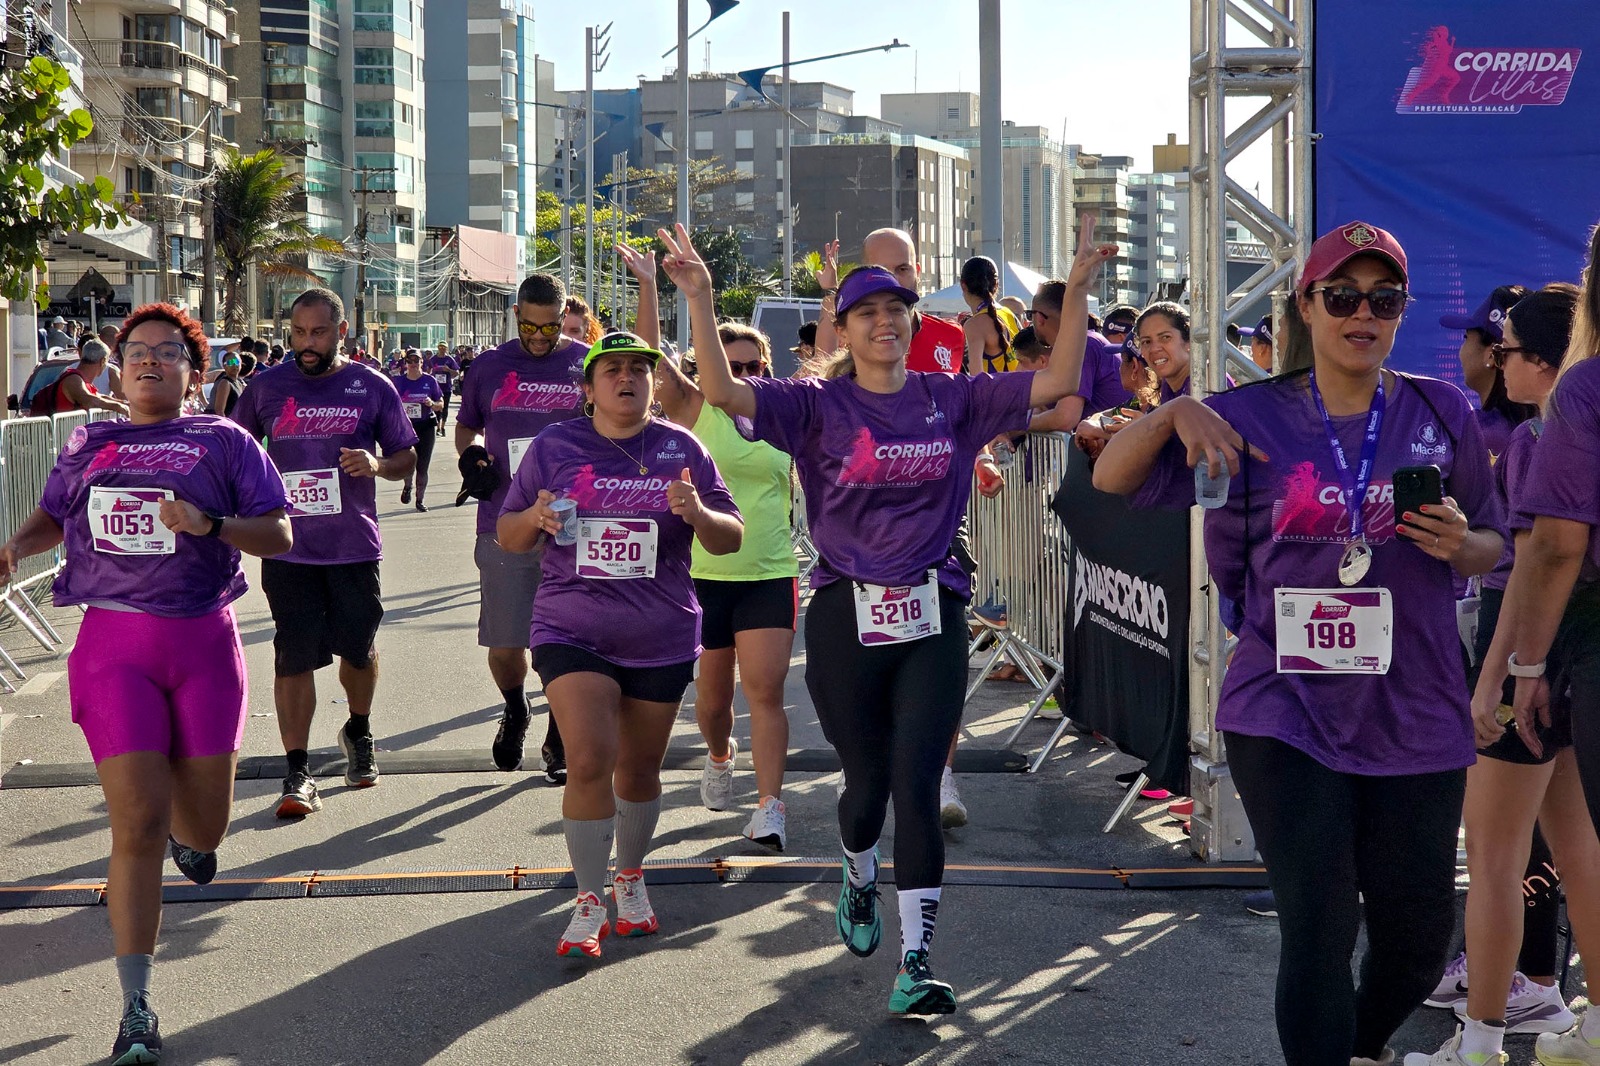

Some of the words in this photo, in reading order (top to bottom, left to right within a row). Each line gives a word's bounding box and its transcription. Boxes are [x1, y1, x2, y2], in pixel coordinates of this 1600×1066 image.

[1454, 52, 1573, 72] CORRIDA
[1469, 64, 1563, 103] Lilás
[1484, 104, 1515, 112] MACAÉ
[46, 306, 75, 315] ROYAL
[517, 382, 582, 395] CORRIDA
[296, 407, 359, 418] CORRIDA
[117, 443, 200, 457] CORRIDA
[656, 451, 686, 460] Macaé
[875, 440, 952, 459] CORRIDA
[1411, 442, 1447, 455] Macaé
[593, 477, 672, 491] CORRIDA
[290, 487, 329, 504] 5333
[100, 514, 154, 535] 1053
[587, 540, 642, 561] 5320
[870, 598, 922, 626] 5218
[1303, 622, 1356, 649] 198
